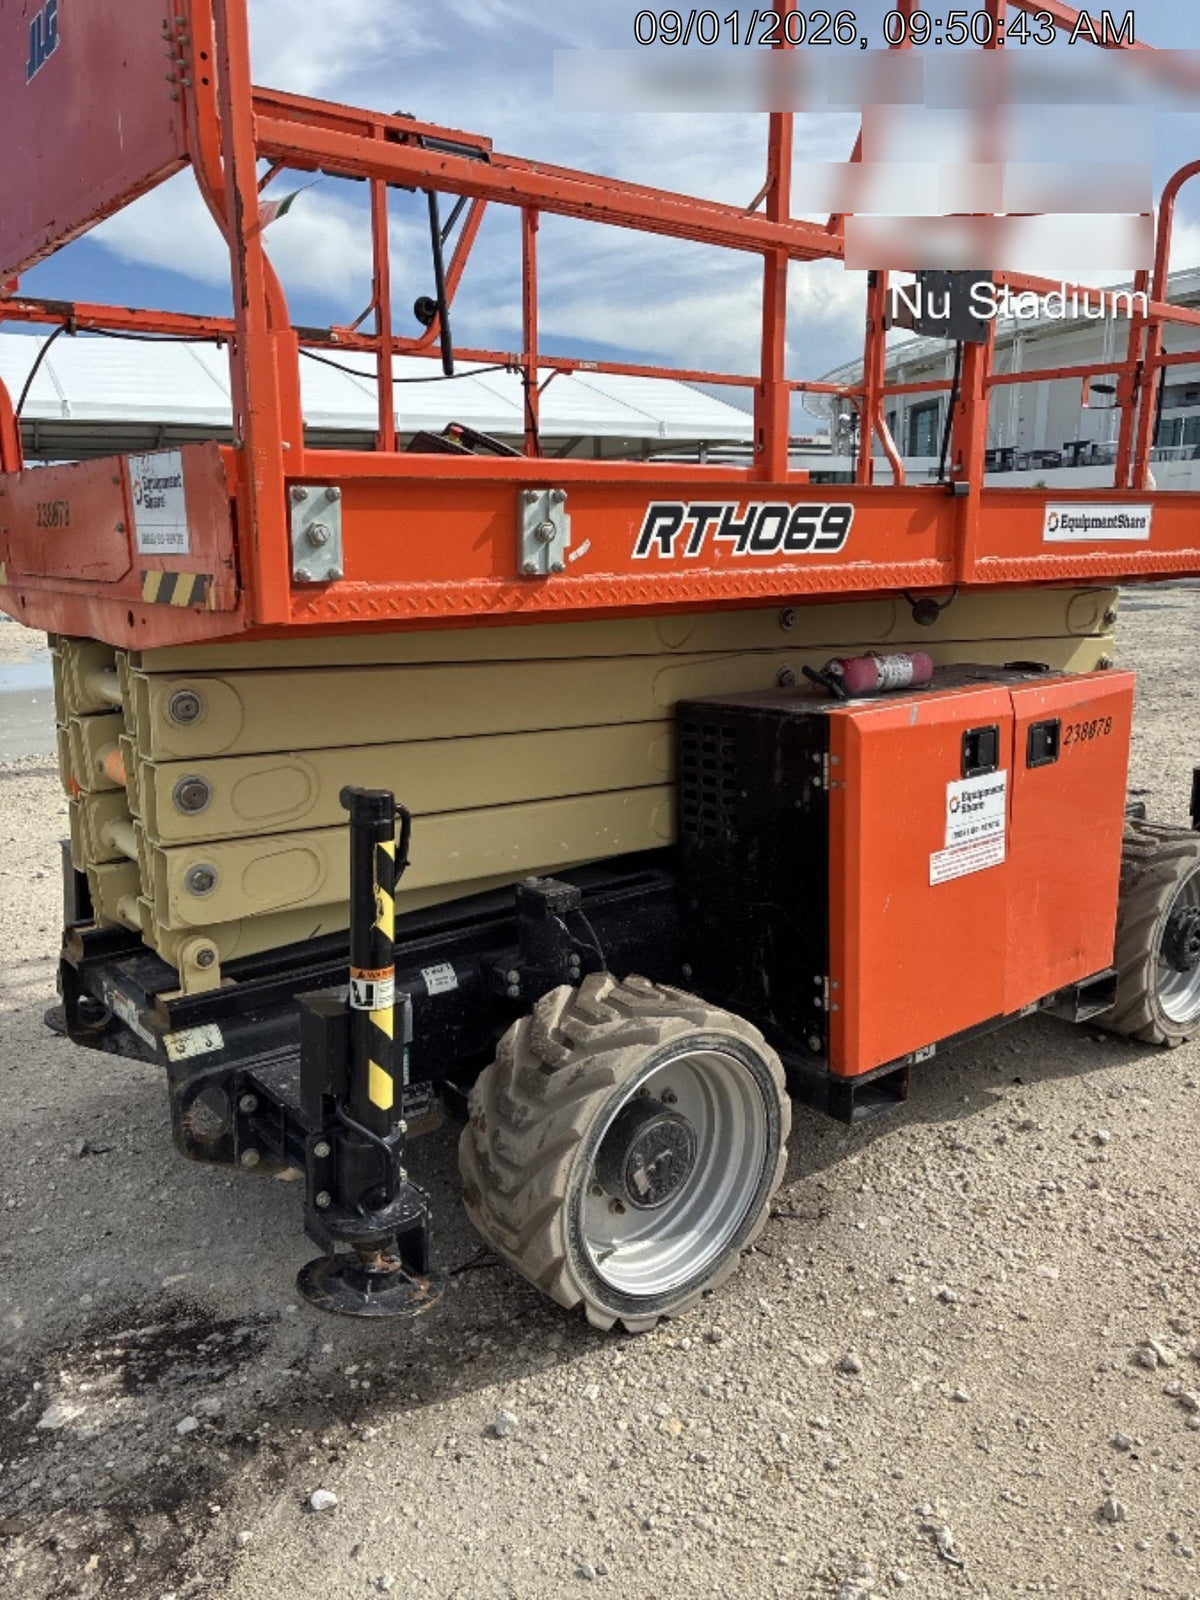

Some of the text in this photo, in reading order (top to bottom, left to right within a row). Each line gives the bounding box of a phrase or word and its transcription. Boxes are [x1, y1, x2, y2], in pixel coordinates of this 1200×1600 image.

[631, 501, 854, 558] RT4069
[1060, 513, 1147, 532] EquipmentShare
[1063, 716, 1112, 746] 238078
[961, 783, 1005, 803] Equipment
[961, 801, 985, 814] Share
